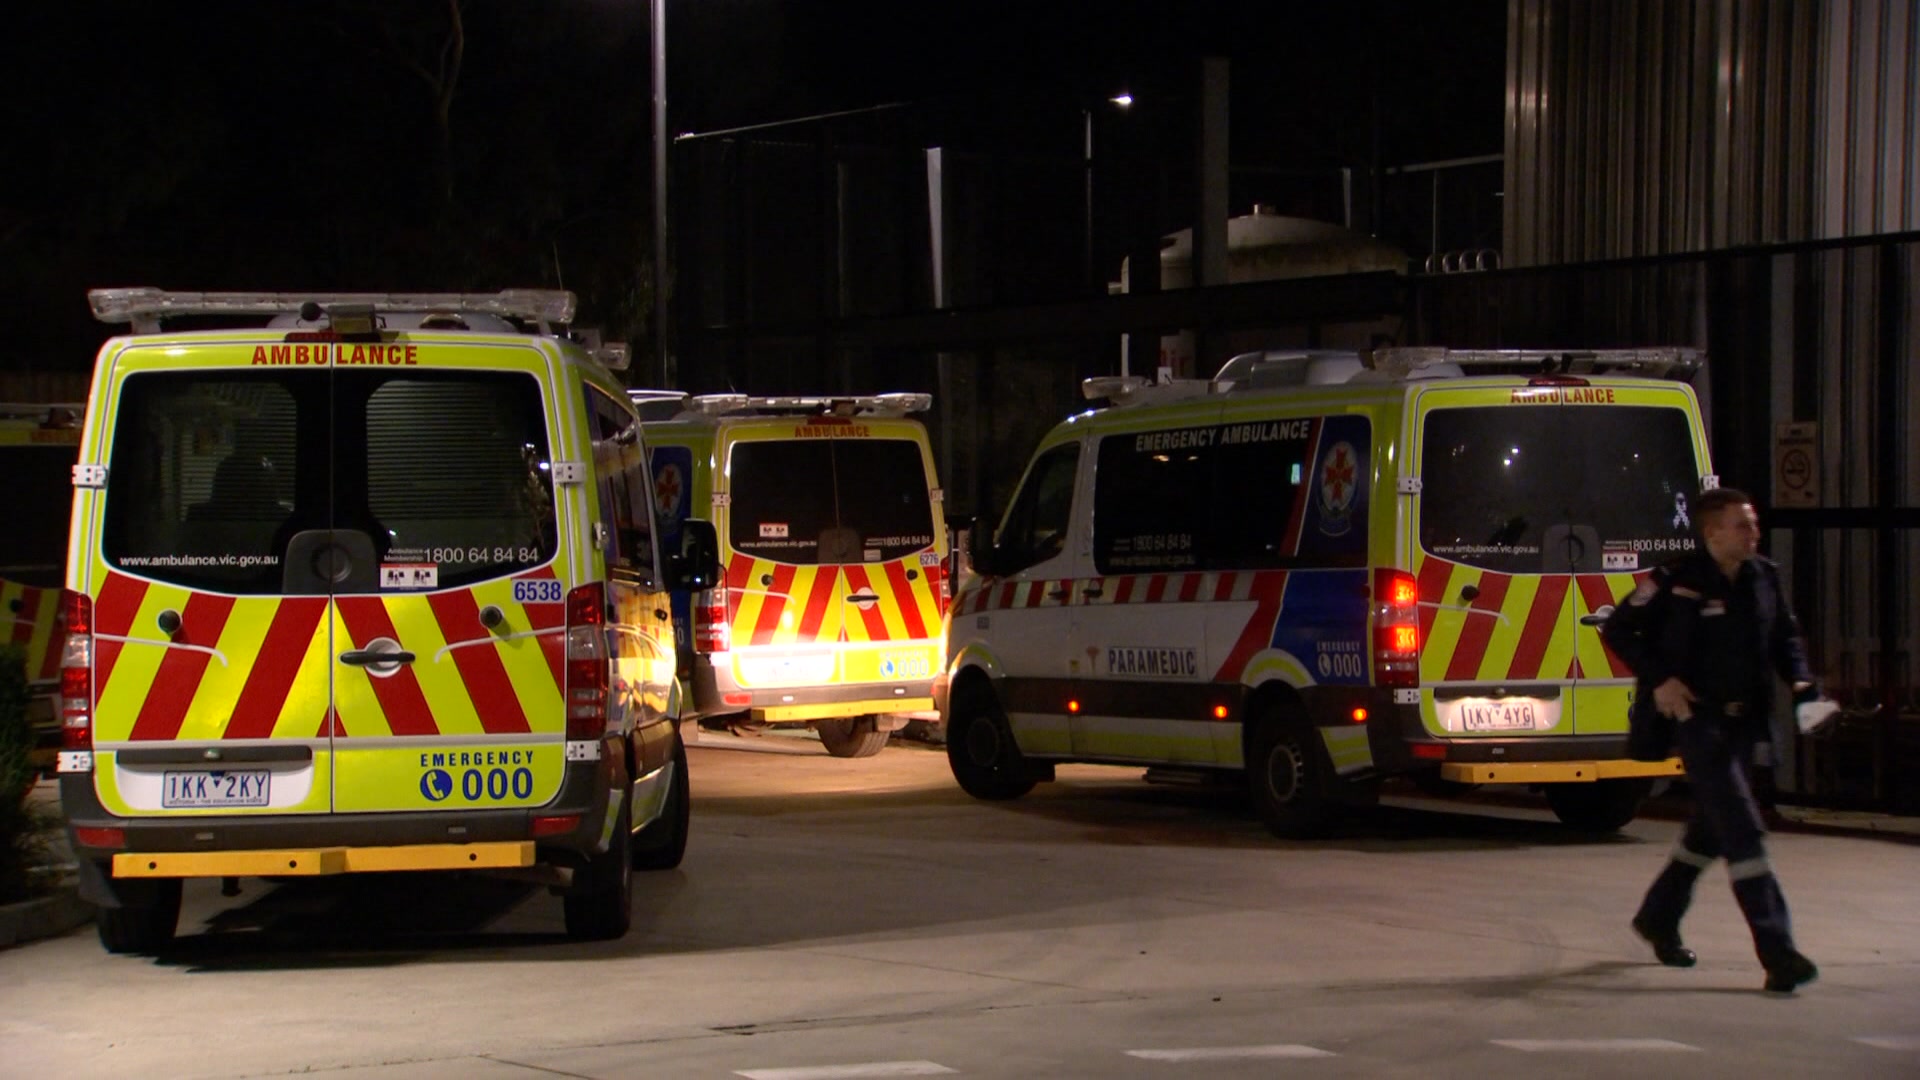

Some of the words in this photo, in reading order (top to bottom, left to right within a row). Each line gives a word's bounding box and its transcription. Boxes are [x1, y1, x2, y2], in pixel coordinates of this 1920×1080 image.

[251, 345, 418, 365] AMBULANCE
[1511, 388, 1615, 403] AMBULANCE
[795, 426, 870, 438] AMBULANCE
[1136, 429, 1216, 452] EMERGENCY
[1221, 420, 1310, 445] AMBULANCE
[1433, 545, 1539, 555] www.ambulance.vic.gov.au
[1629, 539, 1653, 551] 1800
[1654, 539, 1666, 550] 64
[1669, 539, 1681, 550] 84
[1683, 538, 1695, 549] 84
[120, 555, 279, 567] www.ambulance.vic.gov.au
[424, 547, 464, 564] 1800
[468, 547, 488, 564] 64
[493, 547, 513, 563] 84
[518, 547, 539, 563] 84
[919, 553, 939, 565] 6276
[514, 581, 562, 601] 6538
[1108, 649, 1196, 675] PARAMEDIC
[1333, 652, 1362, 678] 000
[420, 750, 534, 767] EMERGENCY
[226, 775, 266, 797] 2KY
[462, 767, 533, 801] 000
